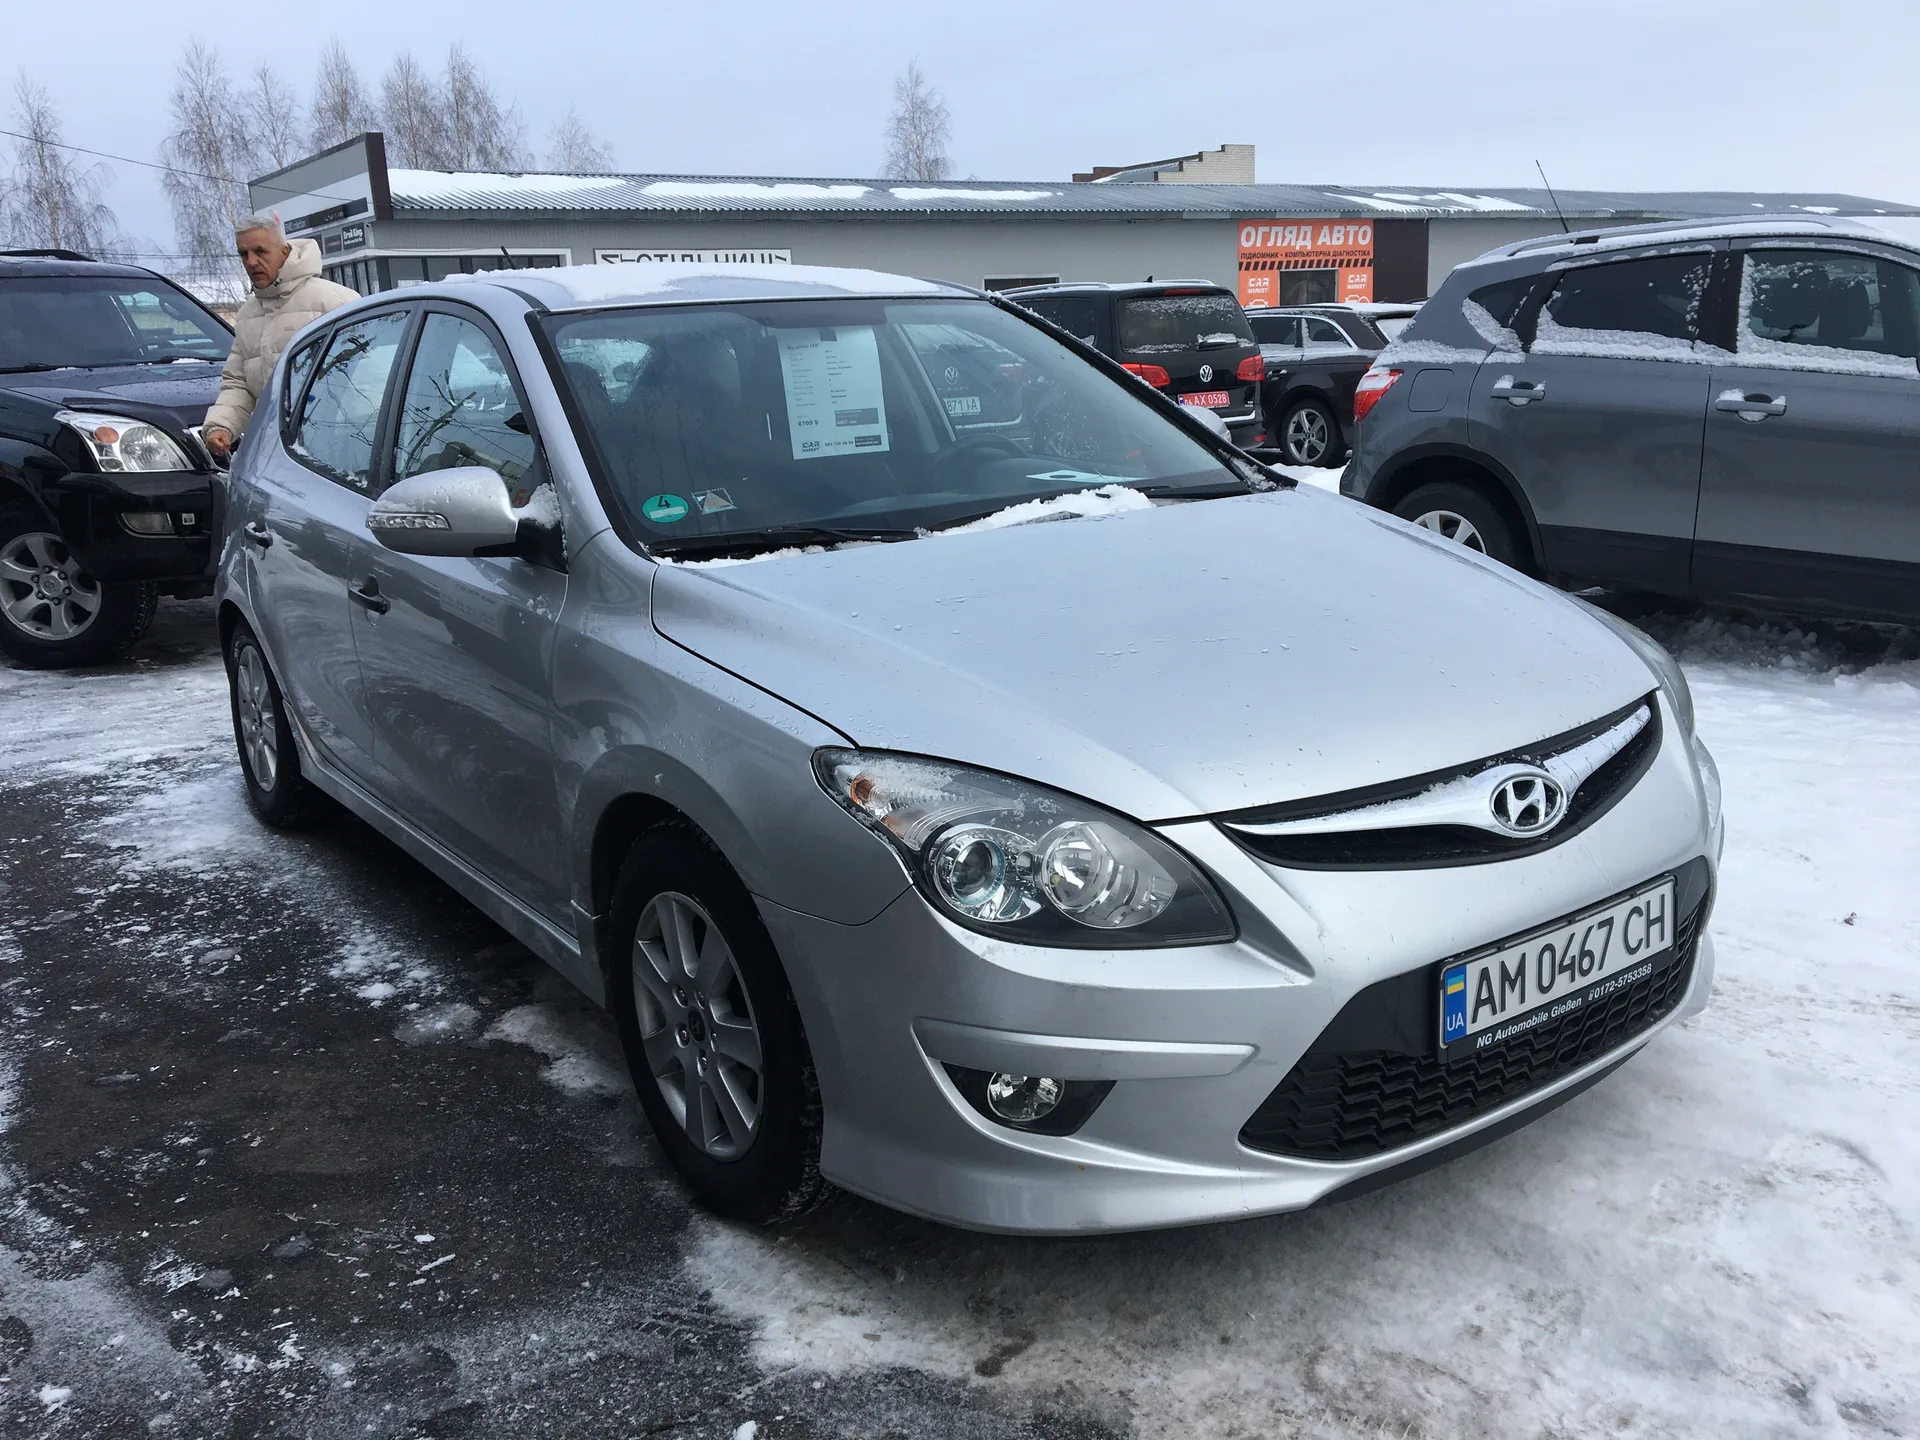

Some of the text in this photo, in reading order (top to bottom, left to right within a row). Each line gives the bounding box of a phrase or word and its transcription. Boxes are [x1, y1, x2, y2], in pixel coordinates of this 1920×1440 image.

[1241, 225, 1372, 250] ОГЛЯД АВТО
[1248, 277, 1270, 287] CAR
[1348, 274, 1368, 283] CAR
[1194, 394, 1207, 406] AX
[1207, 393, 1227, 404] 0528
[657, 495, 671, 509] 4
[1471, 893, 1666, 1025] AM 0467 CH
[1476, 963, 1653, 1049] NG Automobile Gießen 0172-5753358
[1446, 1010, 1465, 1032] UA
